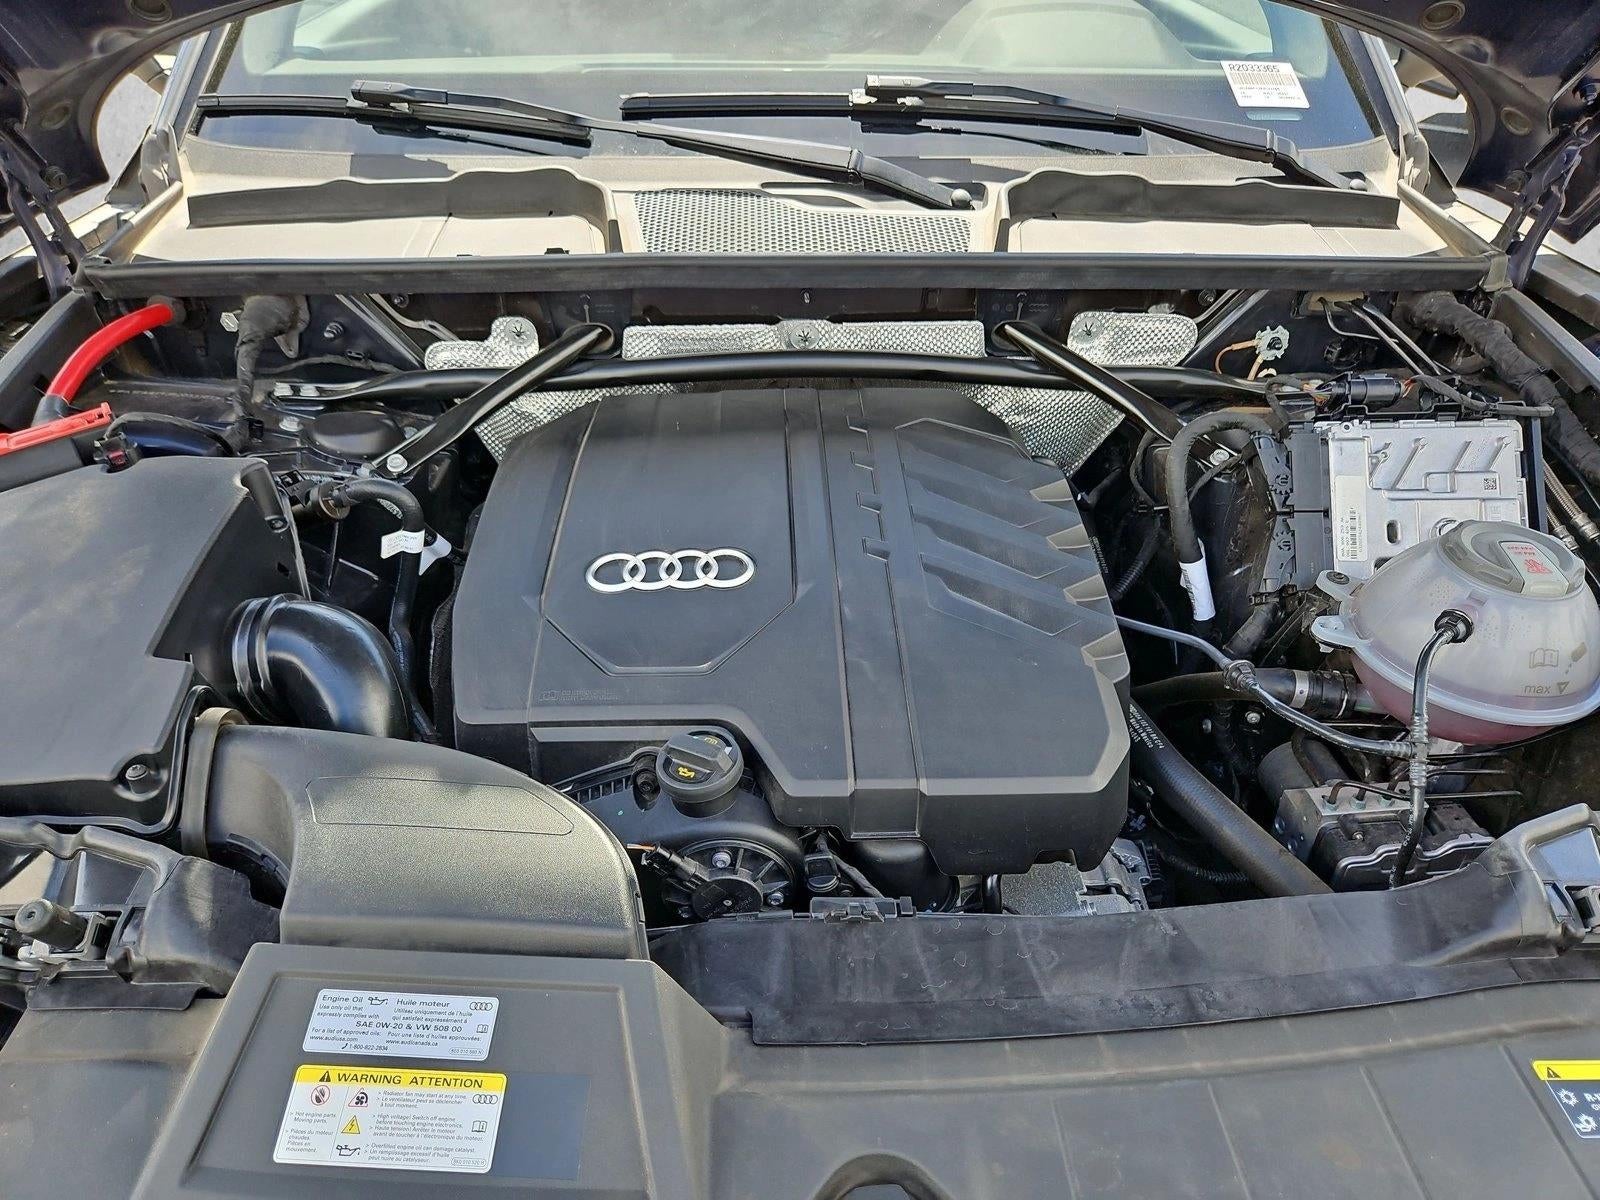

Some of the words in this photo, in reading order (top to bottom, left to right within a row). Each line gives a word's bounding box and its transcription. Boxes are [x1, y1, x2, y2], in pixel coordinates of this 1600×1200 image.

[1228, 64, 1280, 72] R2033365
[1524, 684, 1551, 694] max
[376, 1022, 404, 1030] 0W-20
[338, 1073, 402, 1084] WARNING
[409, 1076, 484, 1088] ATTENTION
